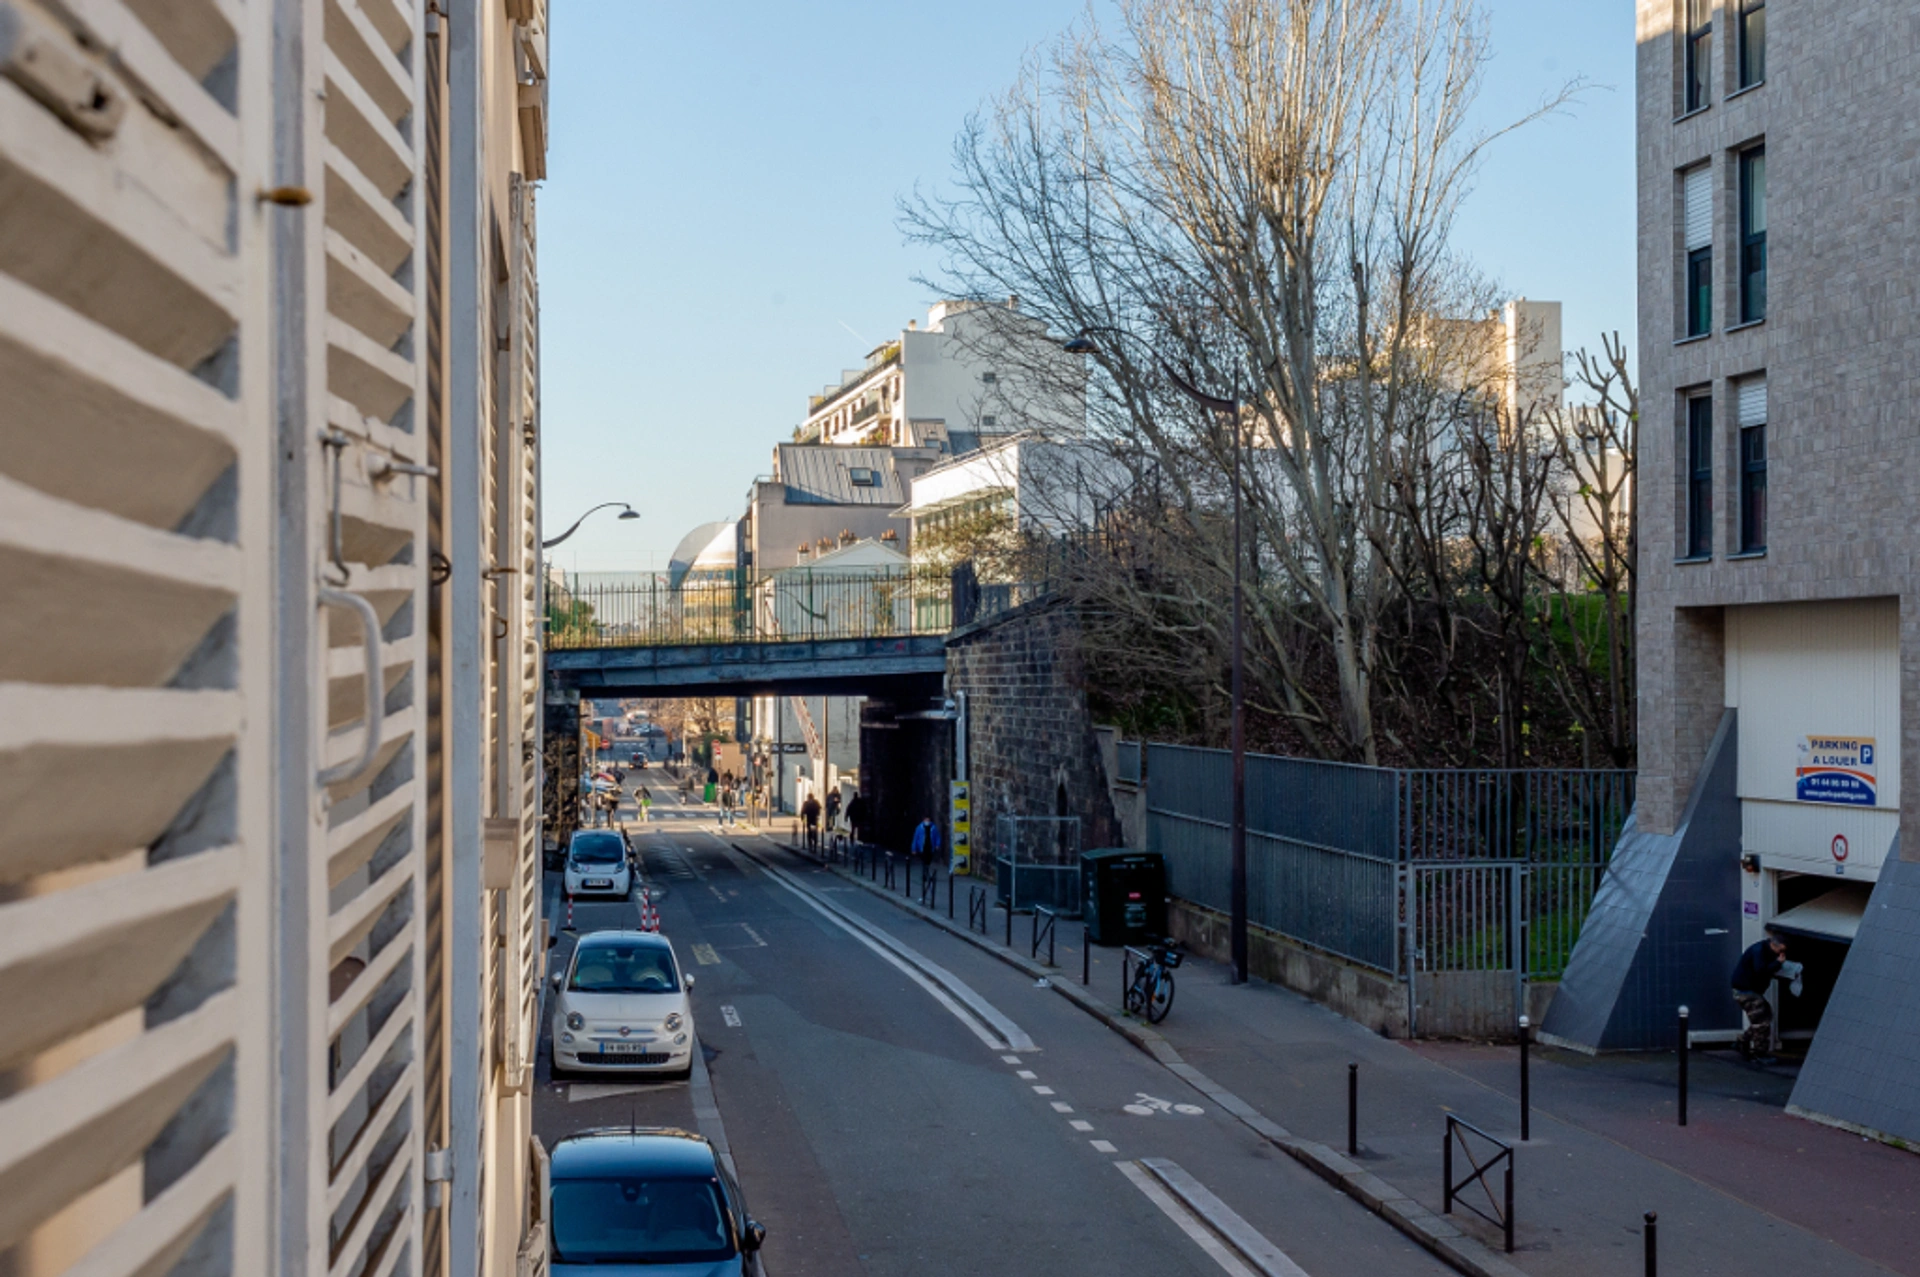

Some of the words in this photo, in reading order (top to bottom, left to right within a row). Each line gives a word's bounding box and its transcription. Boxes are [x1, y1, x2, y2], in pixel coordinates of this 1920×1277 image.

[1811, 739, 1858, 751] PARKING
[1813, 755, 1820, 764] A
[1822, 756, 1858, 766] LOUER
[1863, 747, 1871, 763] P
